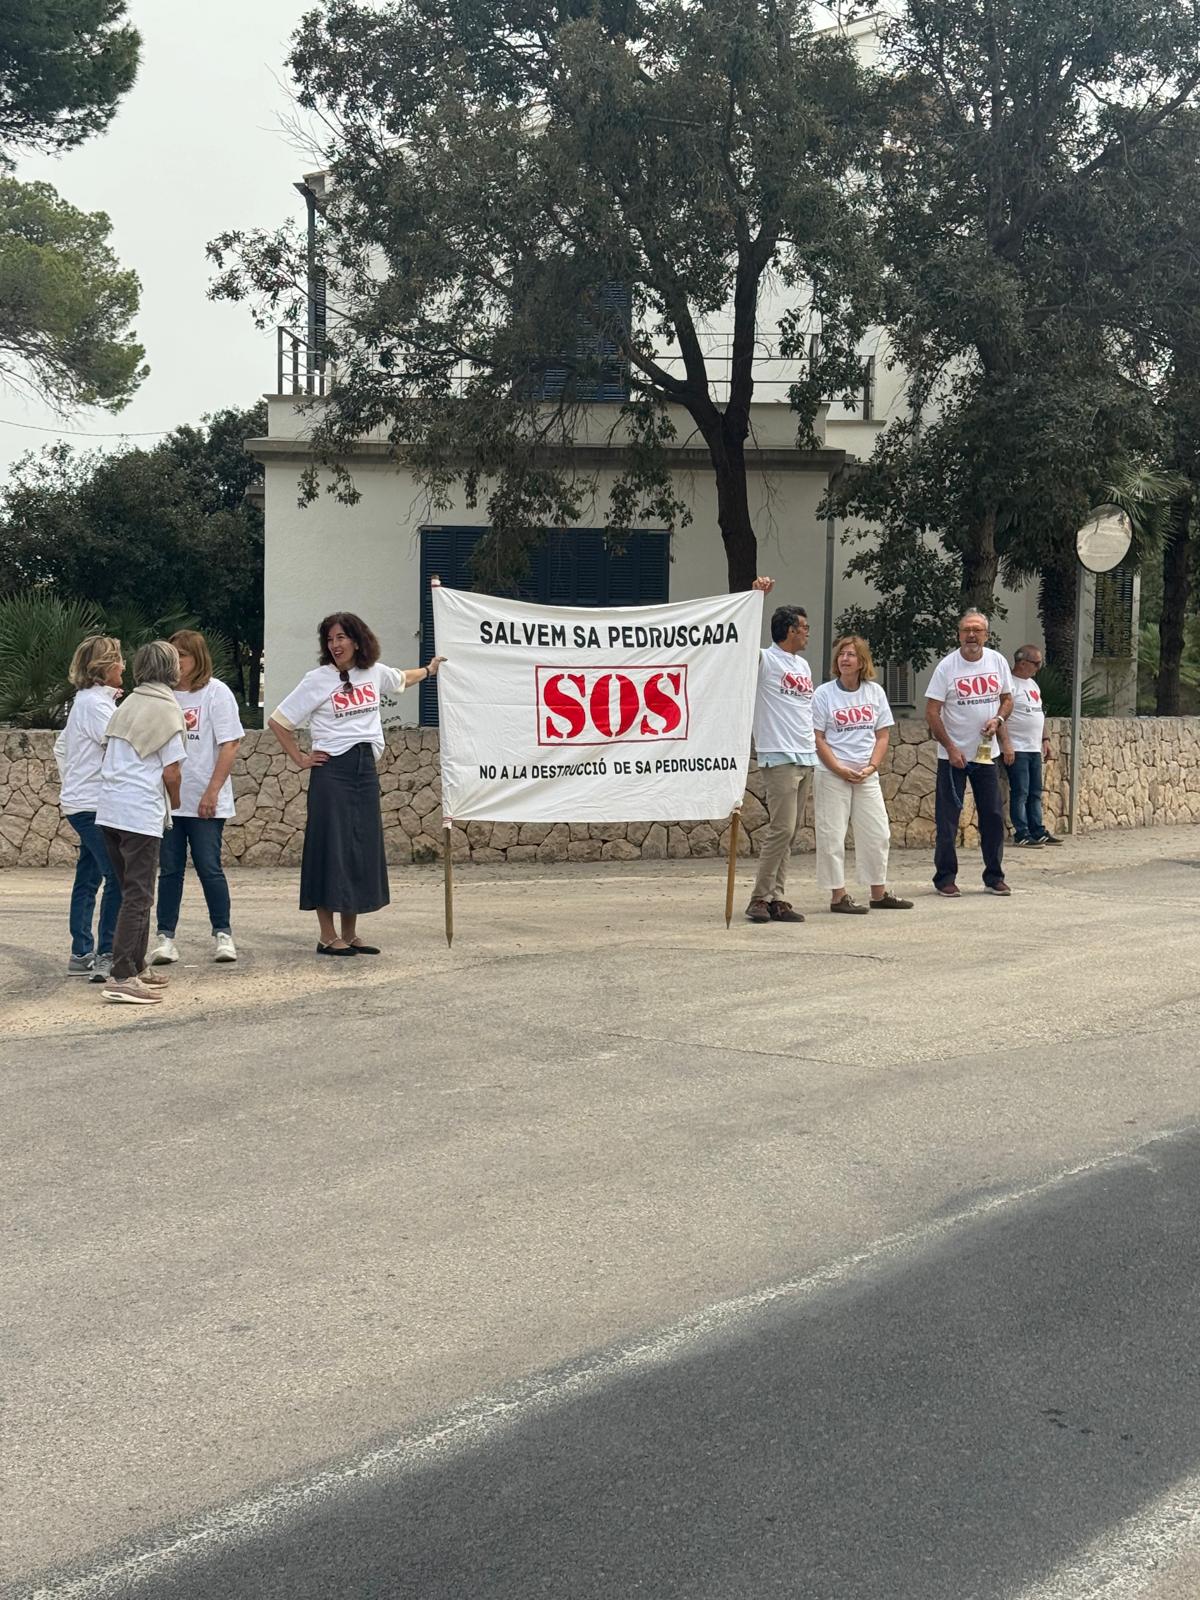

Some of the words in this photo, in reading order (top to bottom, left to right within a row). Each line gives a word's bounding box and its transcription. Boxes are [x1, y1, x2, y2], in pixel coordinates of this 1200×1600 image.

[480, 620, 566, 646] SALVEM
[573, 625, 601, 648] SA
[608, 622, 738, 648] PEDRUSCADA
[333, 684, 376, 711] SOS
[957, 674, 999, 697] SOS
[543, 673, 682, 739] SOS
[835, 705, 872, 725] SOS
[479, 765, 497, 780] NO
[500, 765, 509, 780] A
[512, 765, 527, 779] LA
[531, 757, 607, 780] DESTRUCCIÓ
[614, 761, 632, 775] DE
[635, 760, 652, 774] SA
[655, 757, 738, 774] PEDRUSCADA
